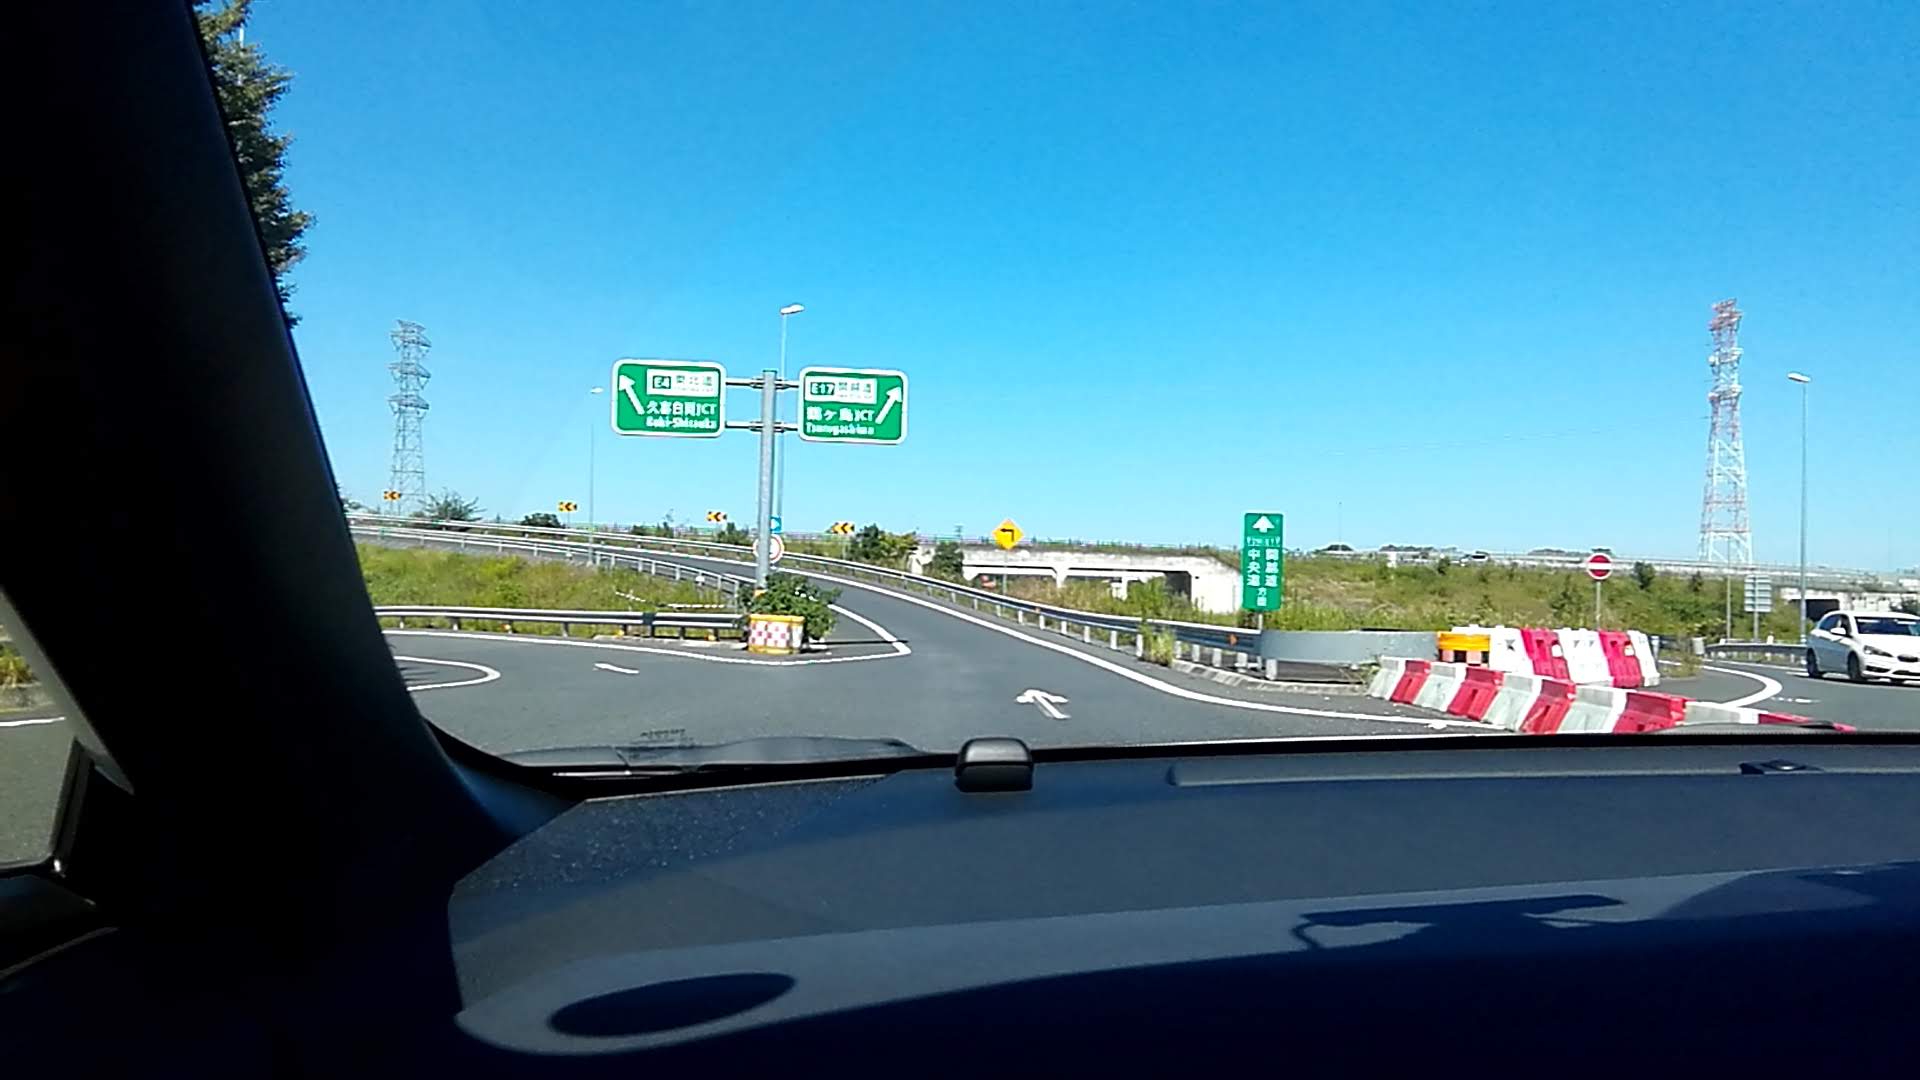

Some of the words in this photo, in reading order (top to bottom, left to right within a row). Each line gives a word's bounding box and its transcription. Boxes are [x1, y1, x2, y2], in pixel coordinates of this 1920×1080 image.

[654, 376, 670, 388] E4
[812, 383, 834, 395] E17
[1247, 548, 1261, 587] 中央道
